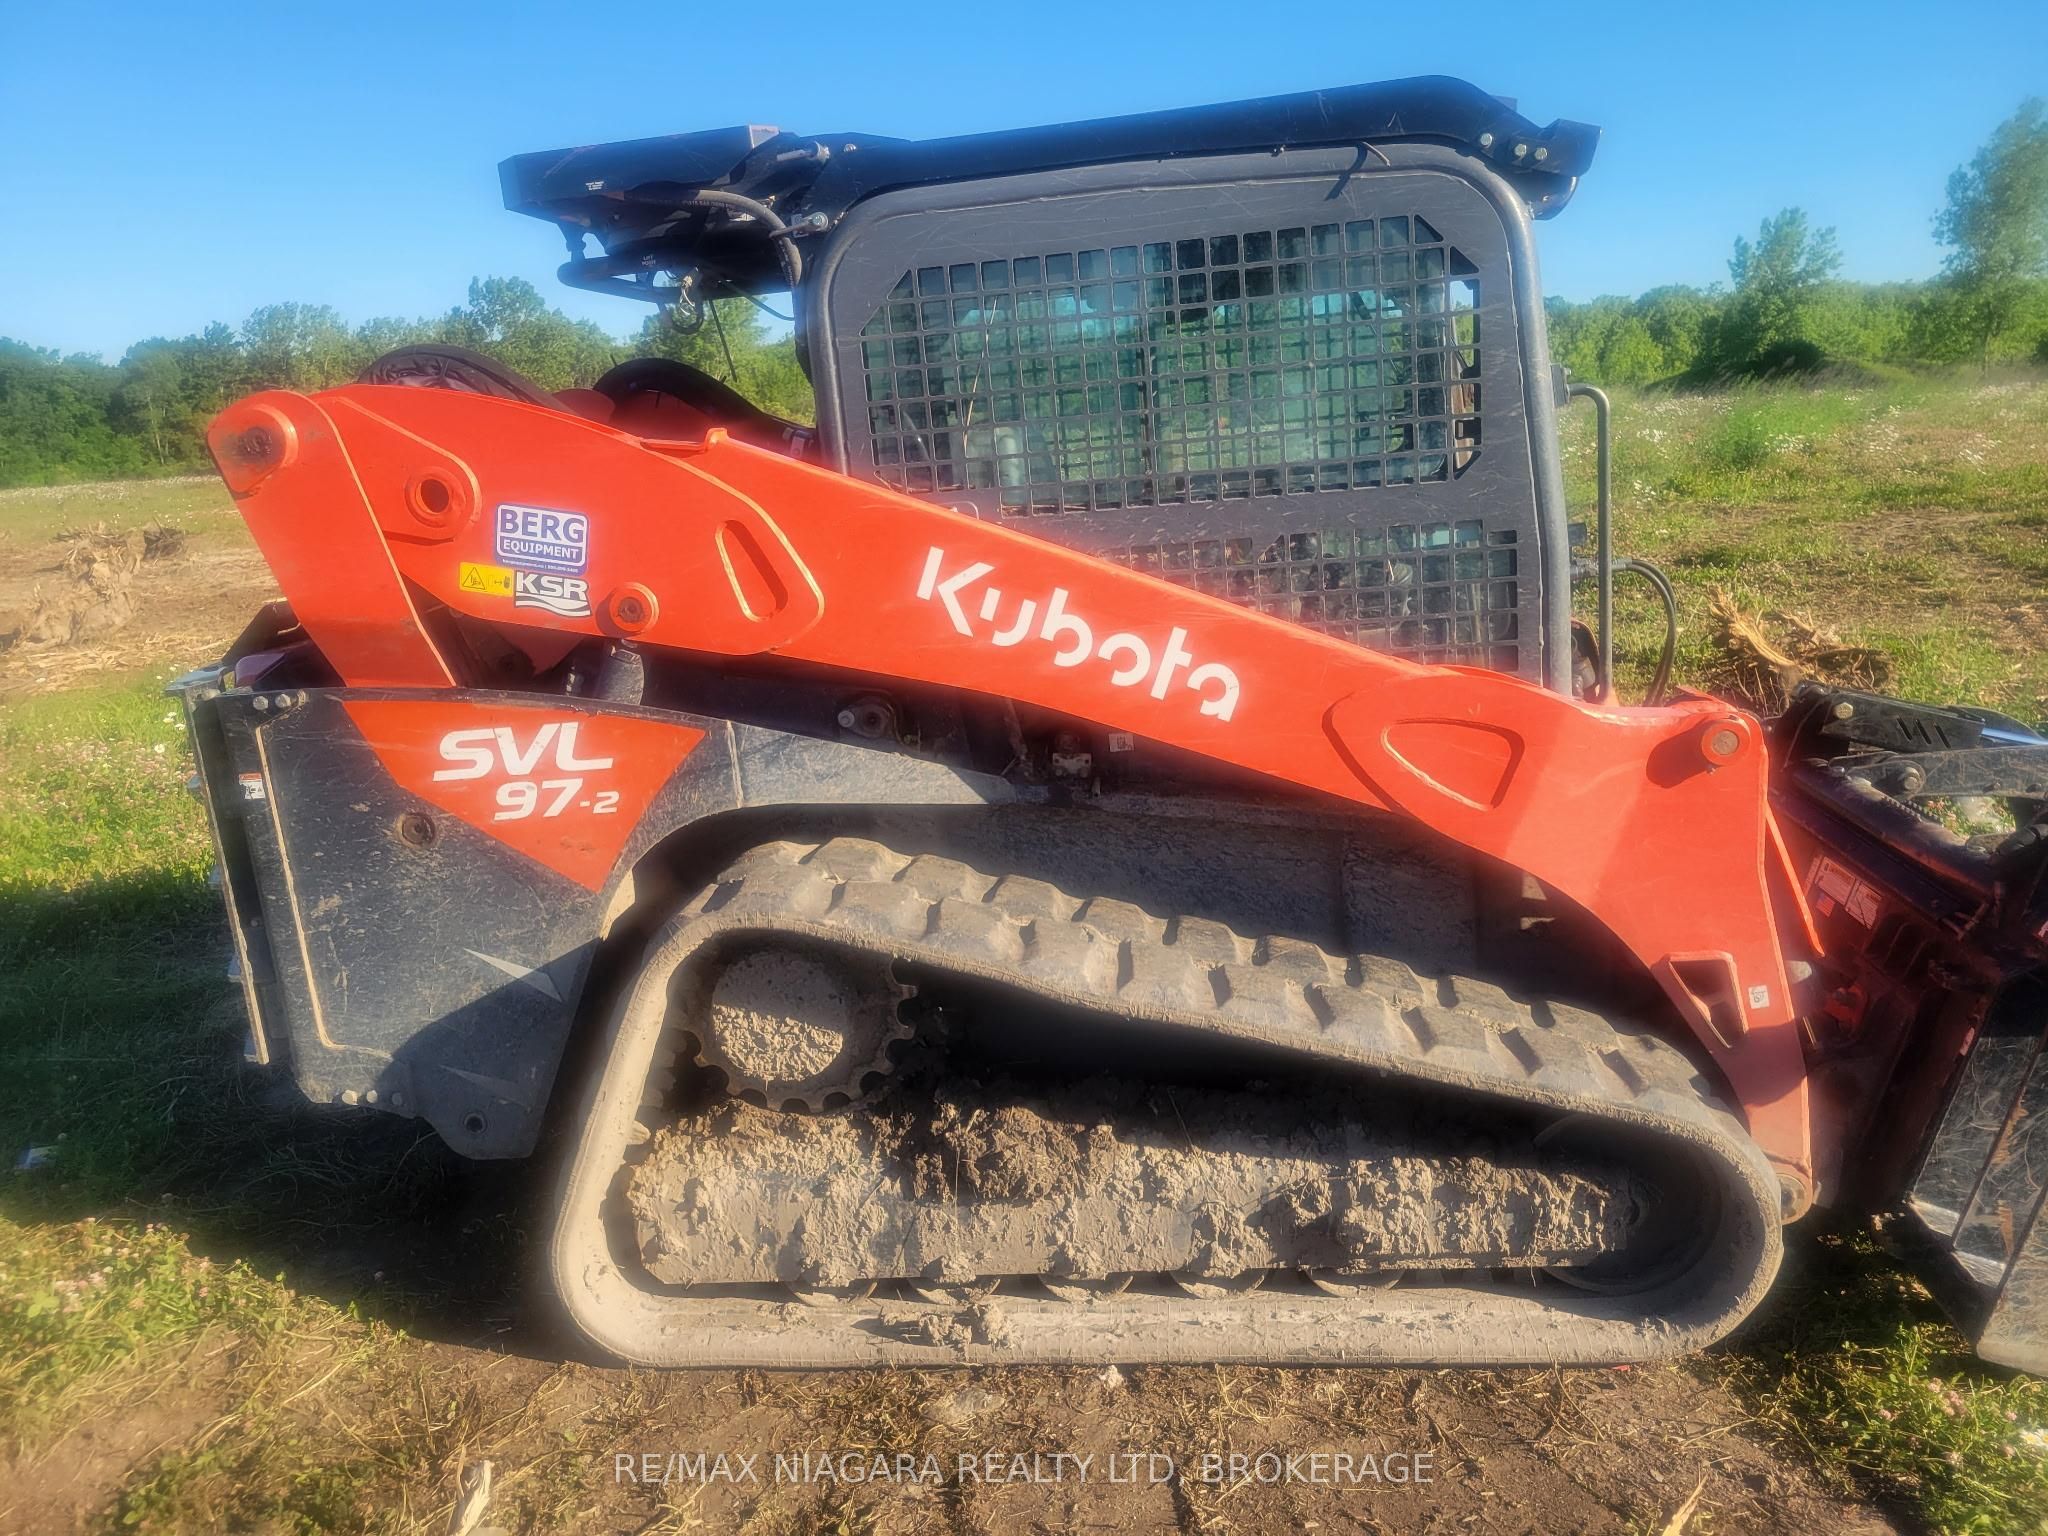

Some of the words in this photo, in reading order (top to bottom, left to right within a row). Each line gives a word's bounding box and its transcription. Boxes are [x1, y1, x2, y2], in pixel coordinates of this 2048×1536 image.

[500, 508, 585, 544] BERG
[503, 539, 579, 560] EQUIPMENT
[516, 571, 588, 601] KSR
[916, 546, 1240, 722] Kubota
[432, 721, 614, 782] SVL
[494, 777, 620, 821] 97-2
